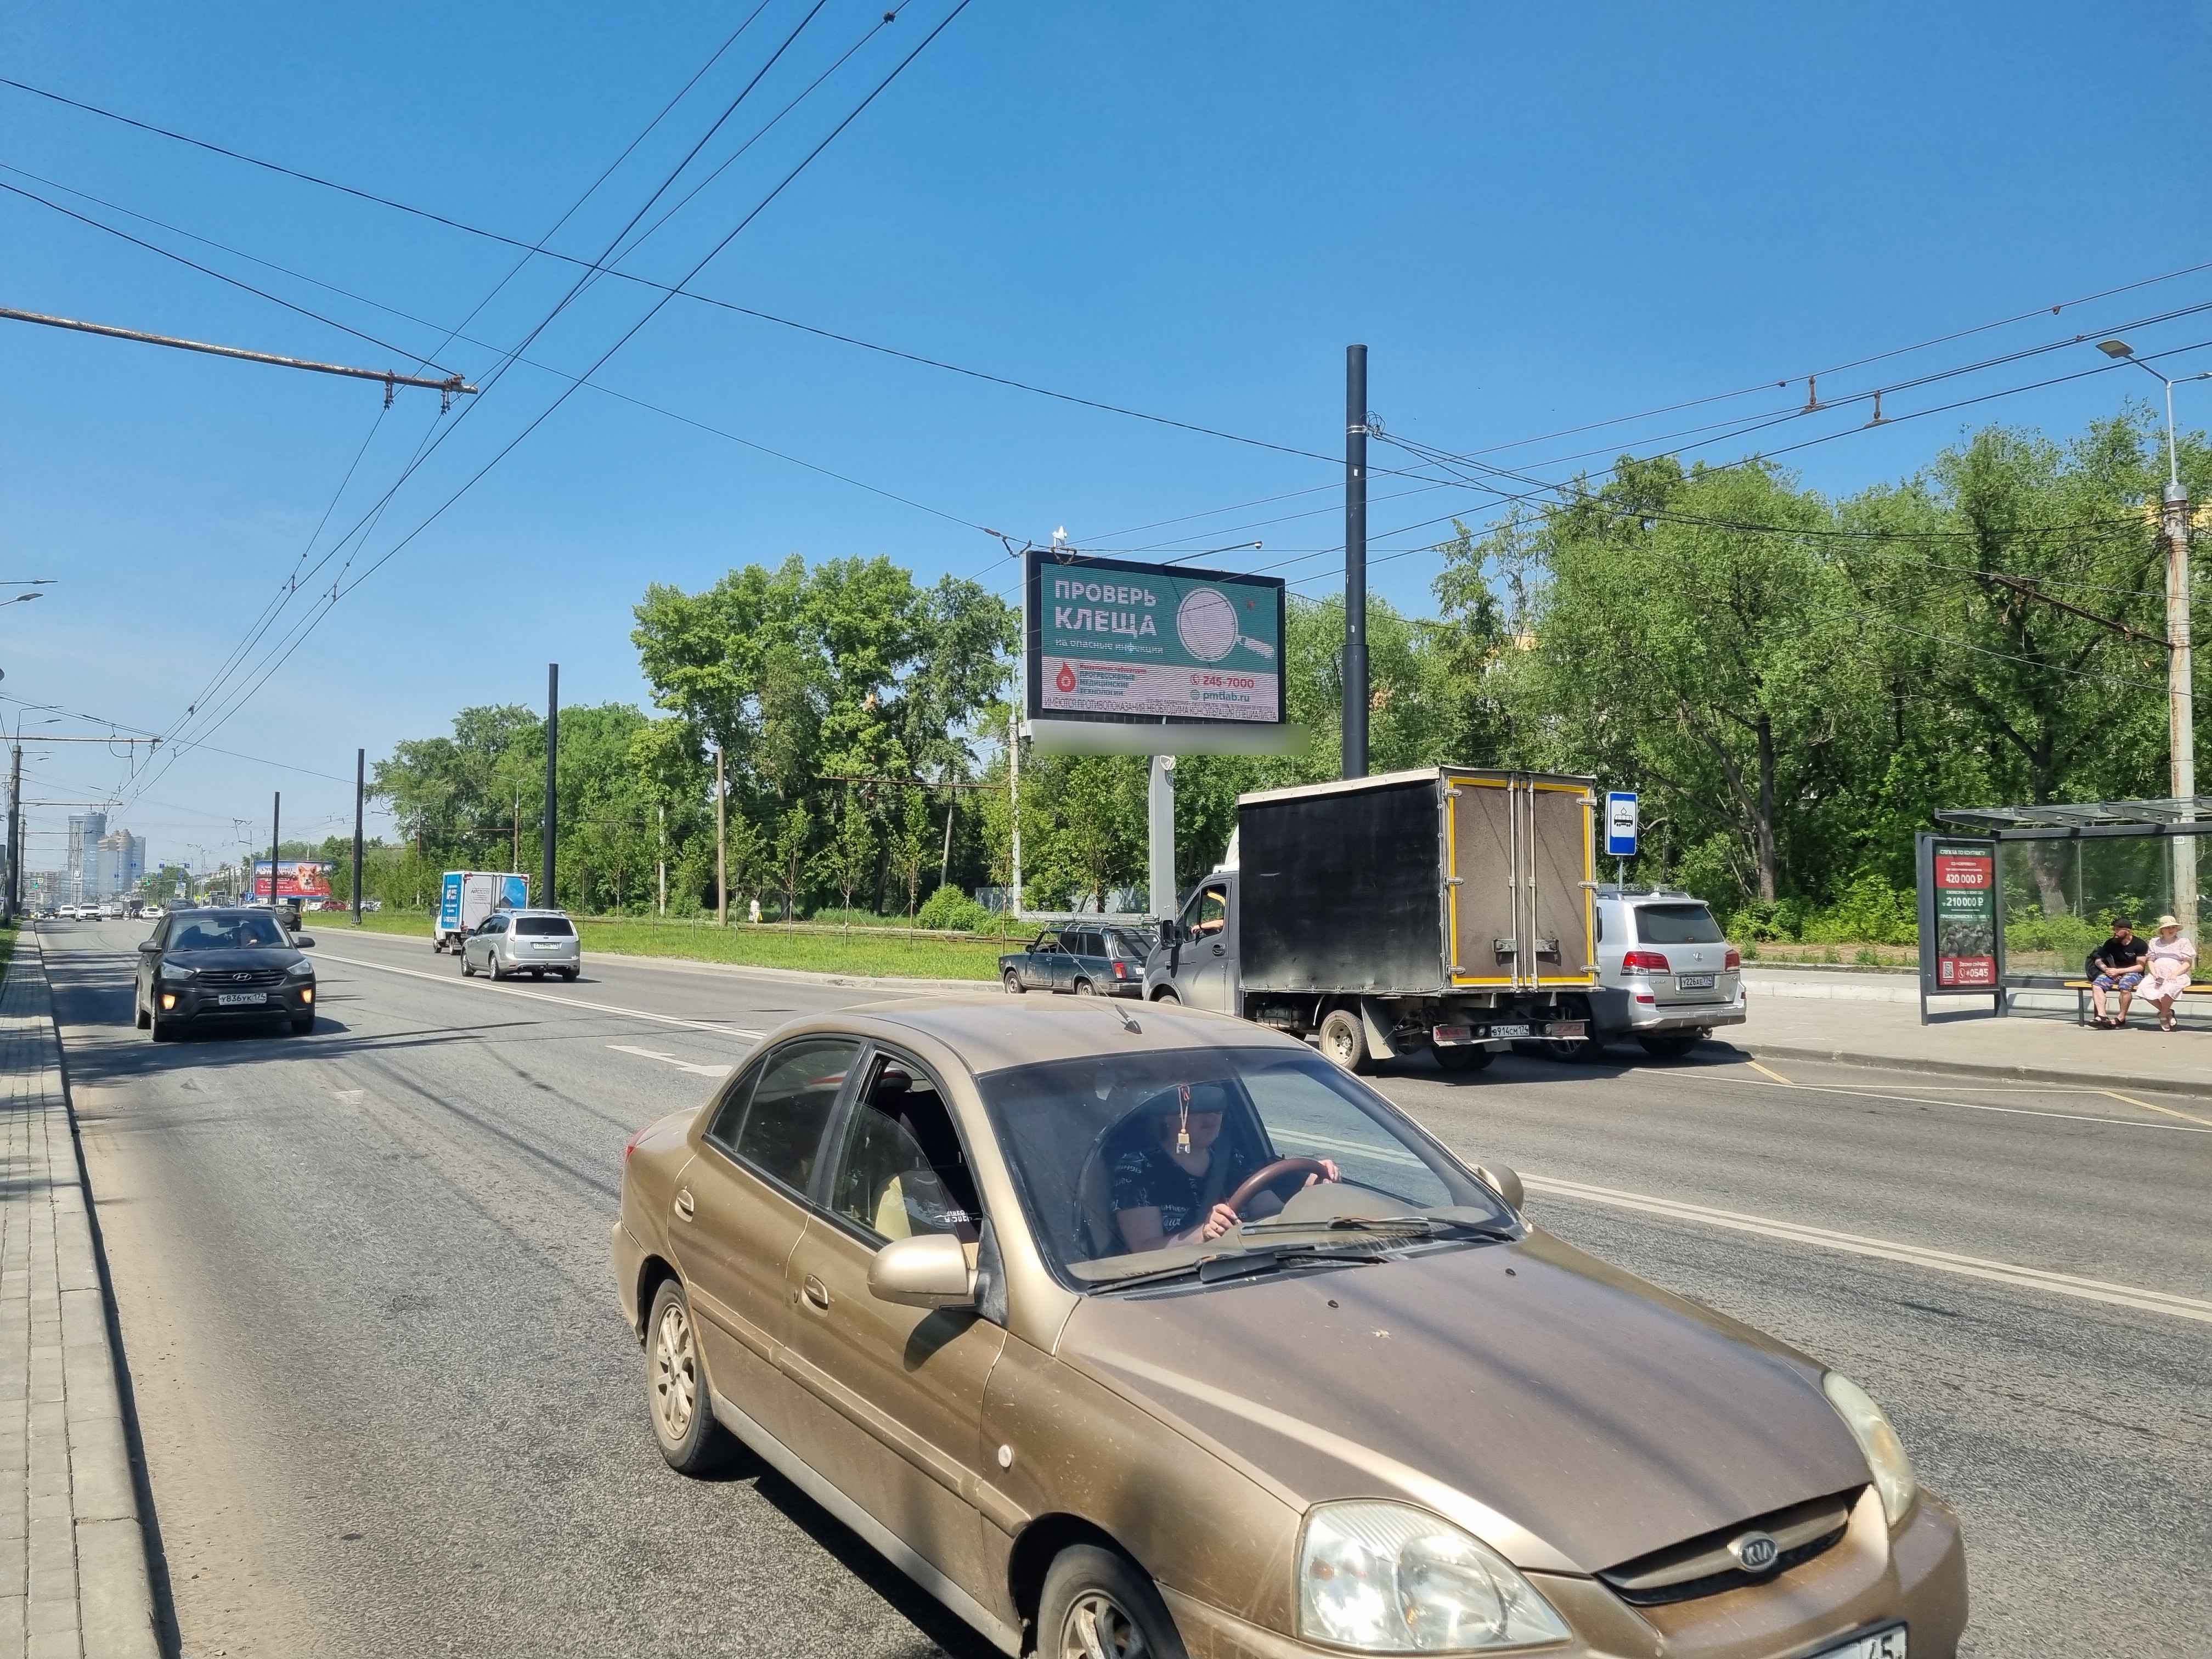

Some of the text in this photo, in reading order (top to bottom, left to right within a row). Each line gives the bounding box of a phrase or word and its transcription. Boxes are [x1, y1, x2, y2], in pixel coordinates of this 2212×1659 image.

[1055, 580, 1156, 606] ПРОВЕРЬ
[1055, 606, 1157, 639] КЛЕЩА
[1070, 640, 1114, 650] опасные
[1115, 642, 1164, 654] инфекции
[1202, 675, 1255, 689] 245-7000
[1045, 697, 1077, 708] ИМЕЮТСЯ
[1202, 690, 1250, 702] pmtlab.ru
[1946, 874, 1960, 883] 420
[1961, 874, 1976, 884] 000
[1946, 897, 1962, 907] 210
[1962, 897, 1977, 907] 000
[1744, 1541, 1773, 1564] KIA
